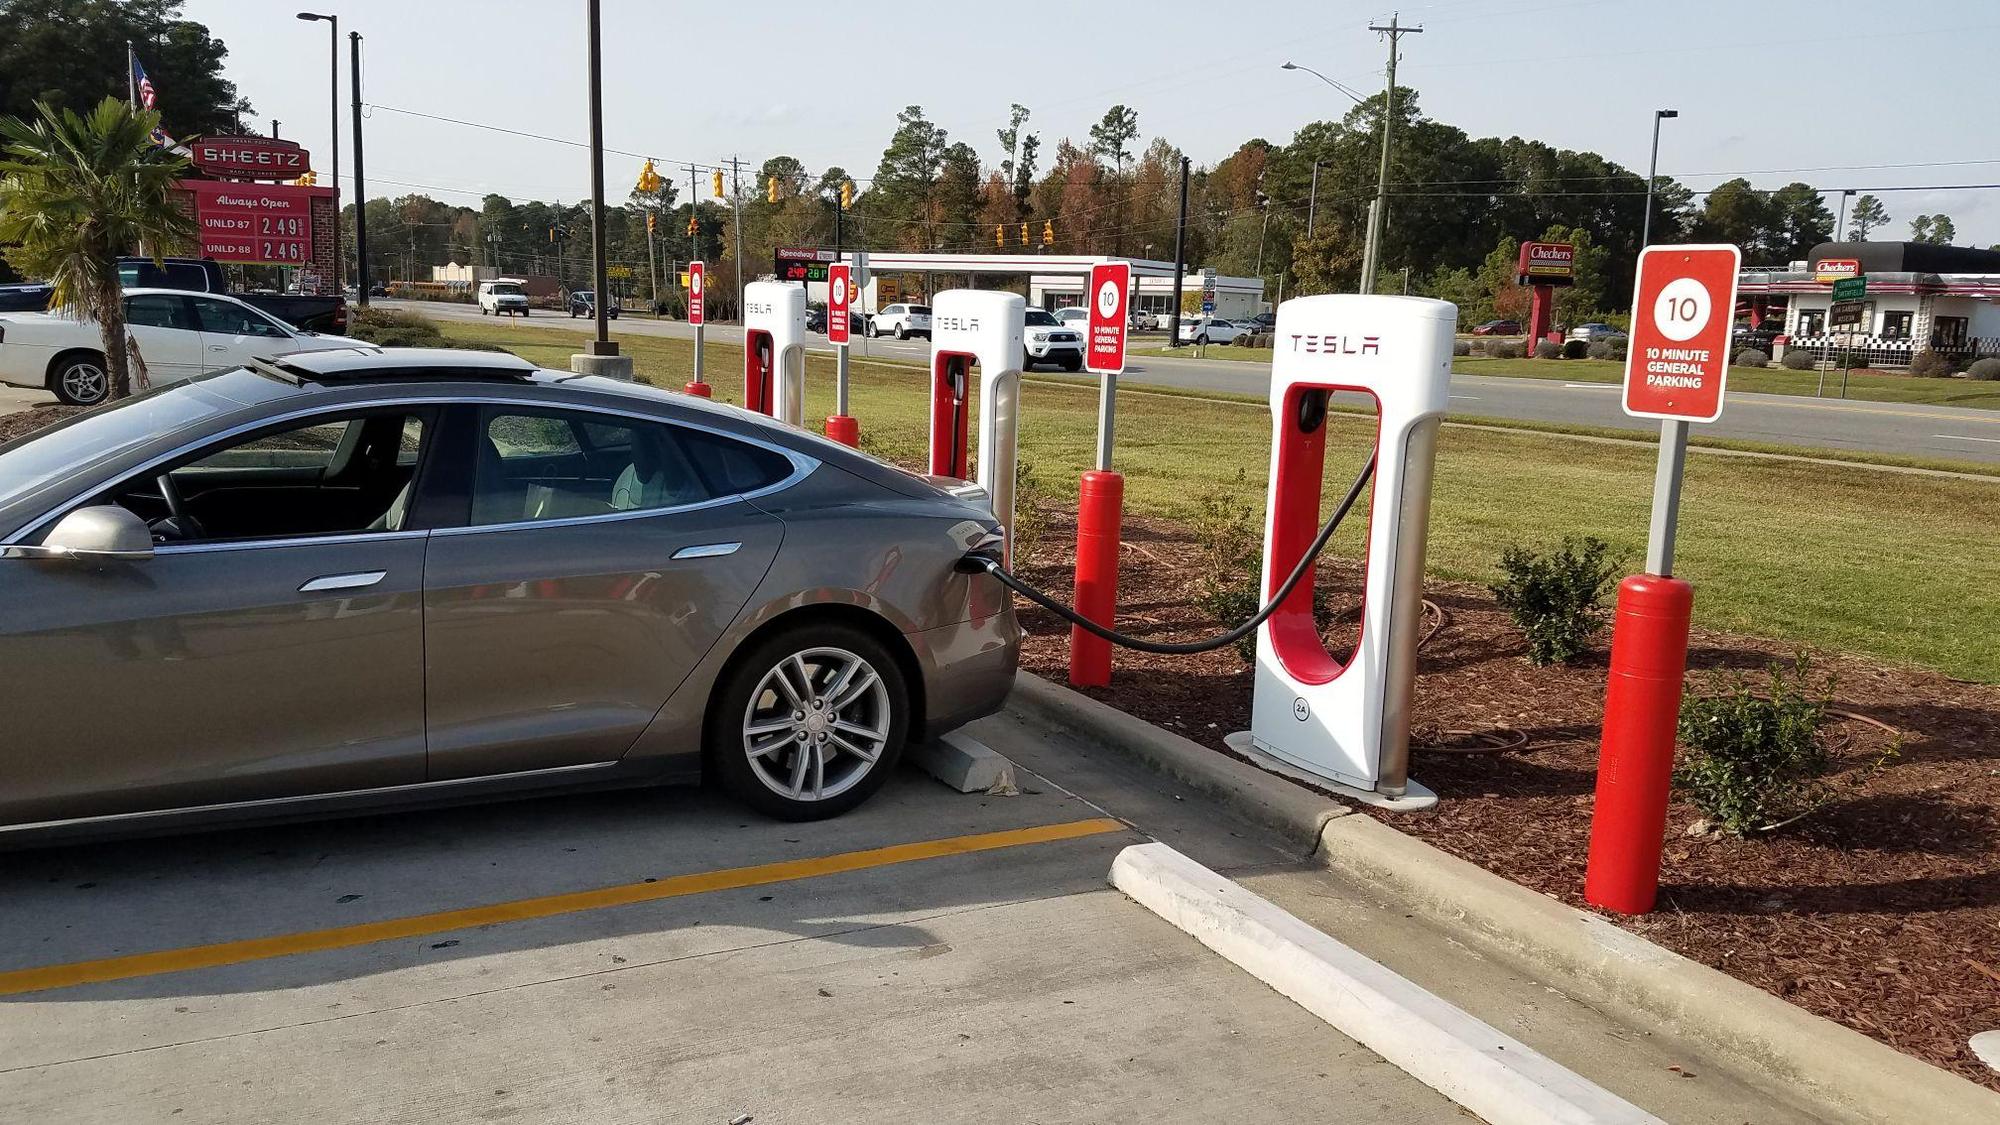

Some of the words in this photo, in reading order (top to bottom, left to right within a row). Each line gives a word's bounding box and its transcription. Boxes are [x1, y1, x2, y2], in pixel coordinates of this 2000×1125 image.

[203, 148, 300, 167] SHEETZ
[216, 195, 258, 209] Always
[260, 197, 290, 209] Open
[205, 218, 235, 228] UNLD
[237, 220, 250, 229] 87
[207, 244, 236, 253] UNLD
[238, 245, 251, 254] 88
[780, 249, 816, 260] Speedway
[1531, 246, 1572, 260] Checkers
[1817, 262, 1856, 272] Checkers
[1103, 291, 1115, 307] 10
[746, 303, 772, 315] TESLA
[1668, 297, 1698, 322] 10
[937, 317, 980, 332] TESLA
[1094, 326, 1100, 334] 10
[1100, 326, 1120, 335] MINUTE
[1094, 335, 1118, 345] GENERAL
[1291, 334, 1381, 355] TESLA
[1094, 345, 1117, 354] PARKING
[1646, 347, 1660, 360] 10
[1661, 348, 1710, 362] MINUTE
[1647, 361, 1705, 376] GENERAL
[1646, 374, 1703, 389] PARKING
[1296, 703, 1307, 714] 2A
